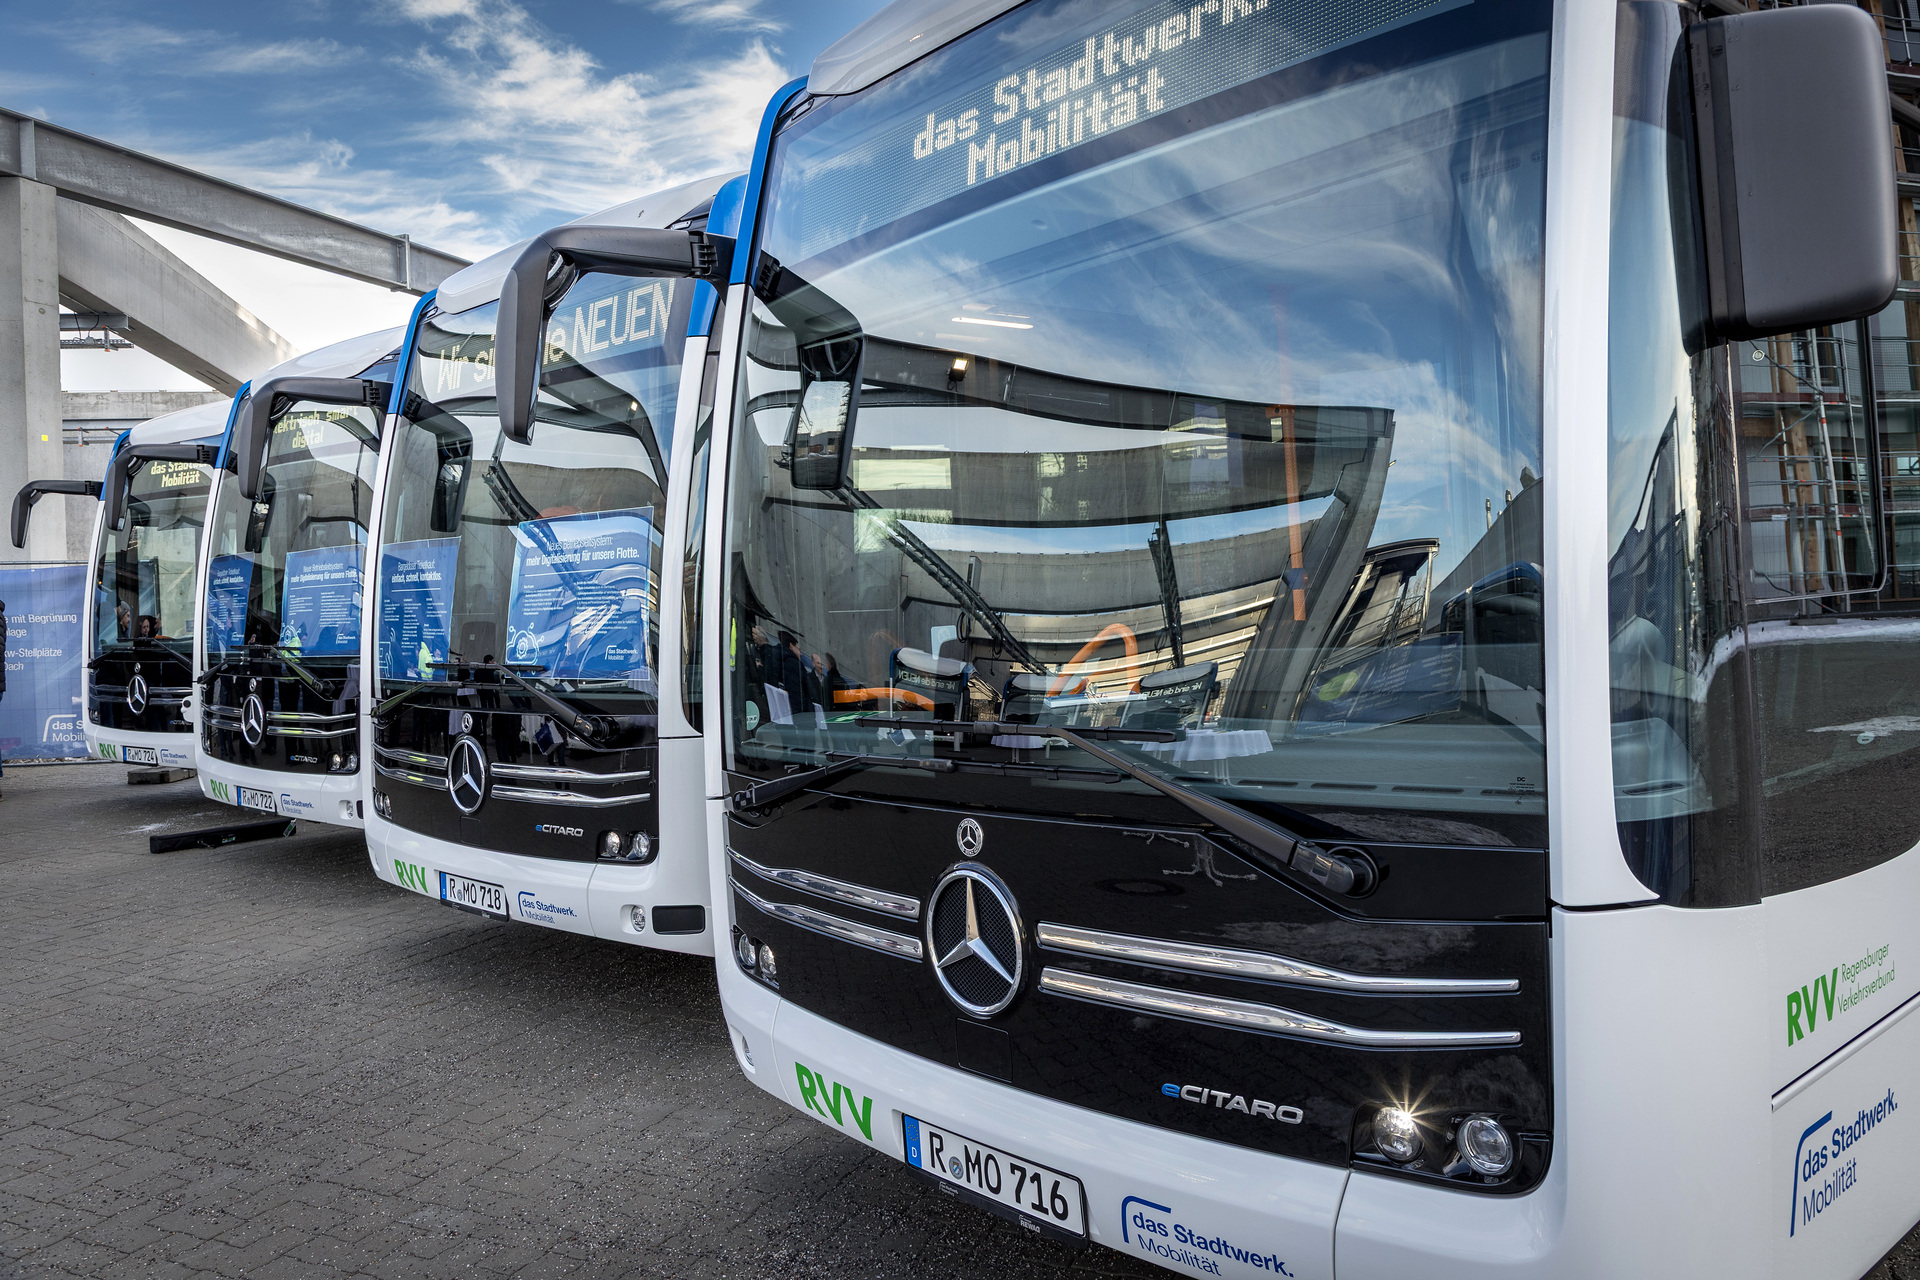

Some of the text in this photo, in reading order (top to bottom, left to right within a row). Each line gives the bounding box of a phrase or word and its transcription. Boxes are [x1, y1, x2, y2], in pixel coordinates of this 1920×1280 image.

[913, 107, 979, 160] das
[967, 66, 1165, 186] Mobilität
[437, 344, 469, 394] Wir
[572, 278, 676, 357] NEUEN
[326, 406, 358, 422] smart
[292, 426, 323, 449] digital
[151, 462, 166, 475] das
[161, 470, 200, 488] Mobilität
[526, 547, 640, 567] mehr Digitalisierung für unsere Flotte.
[11, 615, 26, 624] mit
[28, 614, 77, 625] Begrünung
[52, 721, 74, 730] das
[52, 733, 86, 742] Mobili
[99, 743, 117, 759] RVV
[143, 749, 155, 761] 724
[210, 779, 230, 802] RVV
[243, 790, 247, 803] R
[260, 794, 273, 809] 722
[535, 824, 584, 837] eCITARO
[394, 859, 428, 893] RVV
[449, 878, 501, 910] R MO 718
[522, 898, 577, 918] das Stadtwerk.
[1841, 943, 1889, 983] Regensburger
[1837, 960, 1895, 1014] Verkehrsverbund
[1787, 967, 1838, 1047] RVV
[795, 1061, 873, 1142] RVV
[1161, 1083, 1304, 1125] eCITARO
[1803, 1088, 1898, 1182] das Stadtwerk.
[911, 1146, 918, 1158] D
[929, 1131, 1068, 1221] R MO 716
[1803, 1157, 1857, 1226] Mobilität
[1132, 1212, 1295, 1278] das Stadtwerk.
[1137, 1234, 1222, 1277] Mobilität
